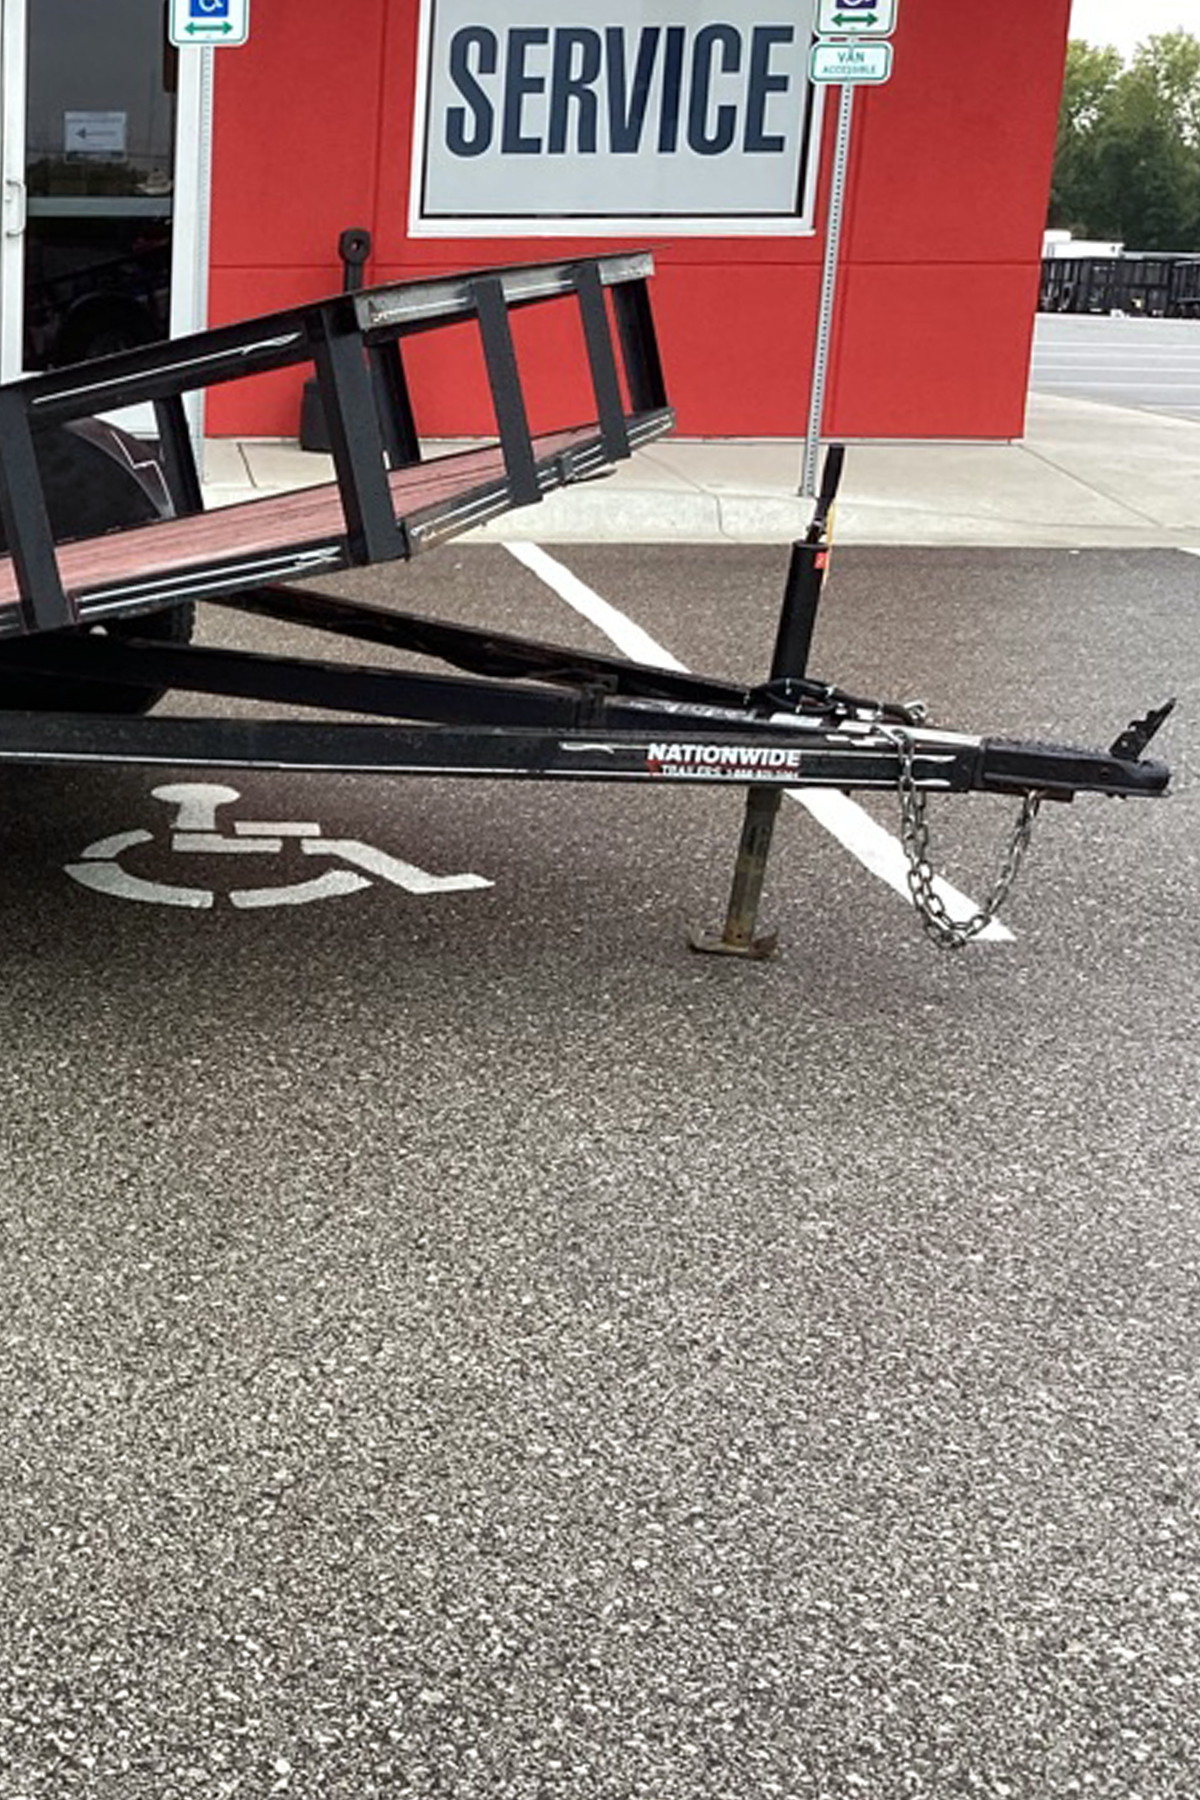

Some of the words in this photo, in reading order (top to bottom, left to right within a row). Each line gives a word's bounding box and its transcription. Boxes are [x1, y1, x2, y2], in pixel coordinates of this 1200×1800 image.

[837, 52, 866, 63] VAN
[445, 23, 795, 157] SERVICE
[647, 743, 800, 767] NATIONWIDE
